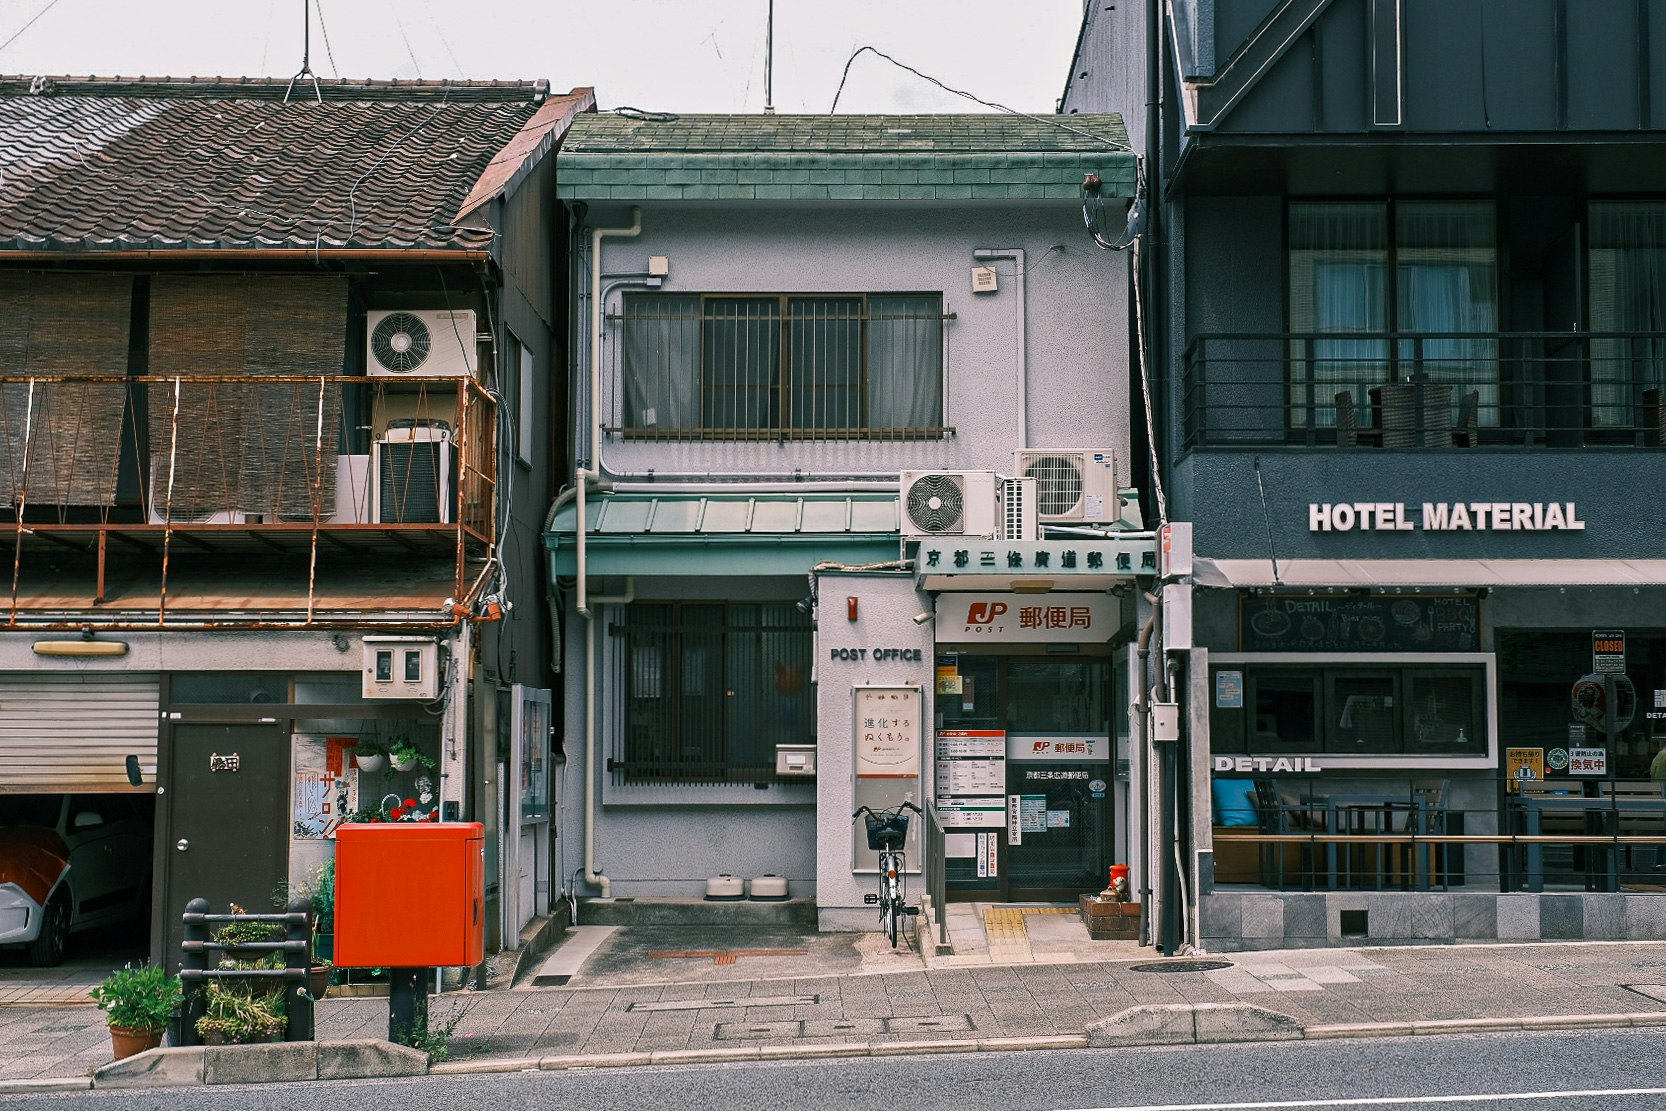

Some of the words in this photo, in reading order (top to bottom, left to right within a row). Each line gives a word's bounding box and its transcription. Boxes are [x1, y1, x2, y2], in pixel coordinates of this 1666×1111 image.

[1309, 502, 1414, 531] HOTEL
[1422, 502, 1585, 531] MATERIAL
[1019, 606, 1092, 630] 郵便局
[1595, 640, 1623, 652] CLOSED
[830, 648, 867, 661] POST
[873, 648, 922, 661] OFFICE
[1055, 743, 1085, 753] 郵便局
[1214, 756, 1321, 772] DETAIL
[1570, 759, 1604, 770] 換気中
